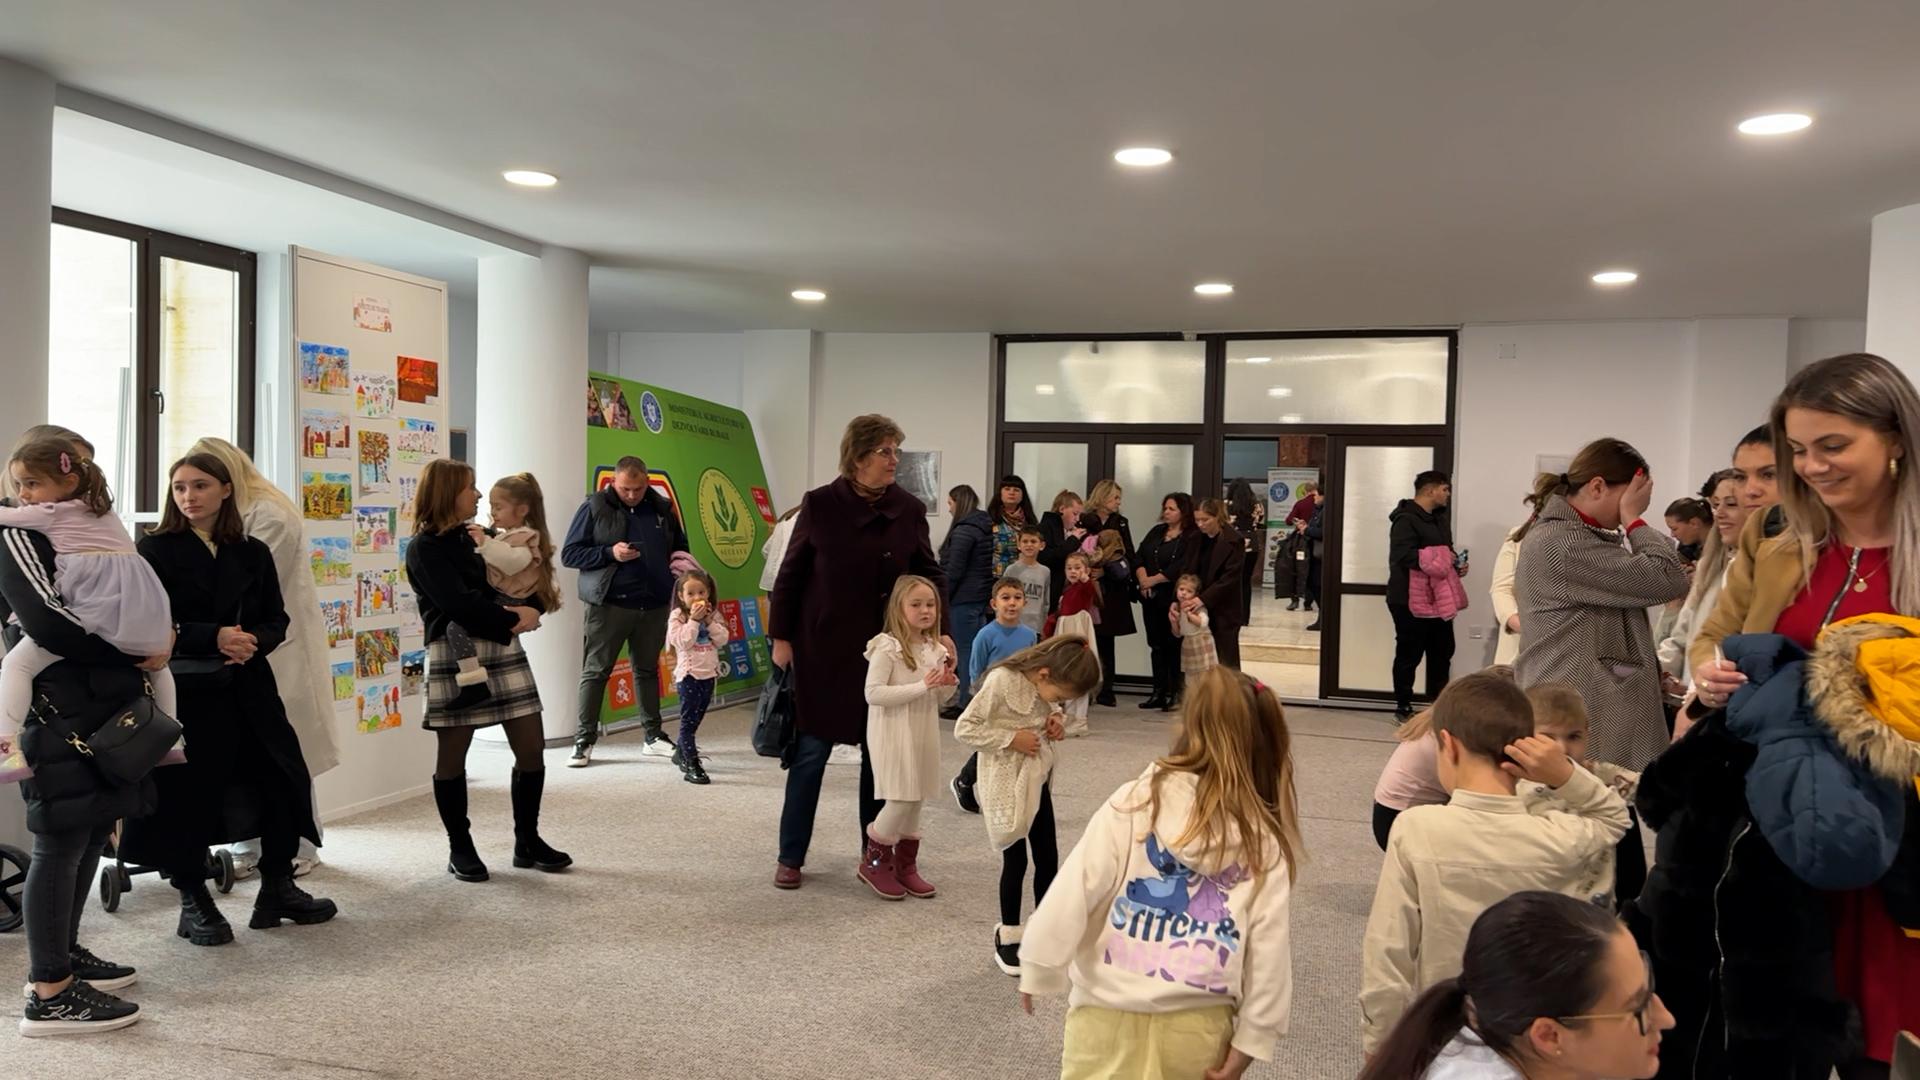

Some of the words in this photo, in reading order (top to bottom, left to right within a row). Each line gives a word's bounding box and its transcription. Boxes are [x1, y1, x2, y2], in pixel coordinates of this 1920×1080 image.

[1111, 896, 1209, 942] STITCH
[1214, 917, 1240, 953] &
[40, 1004, 92, 1020] Karl
